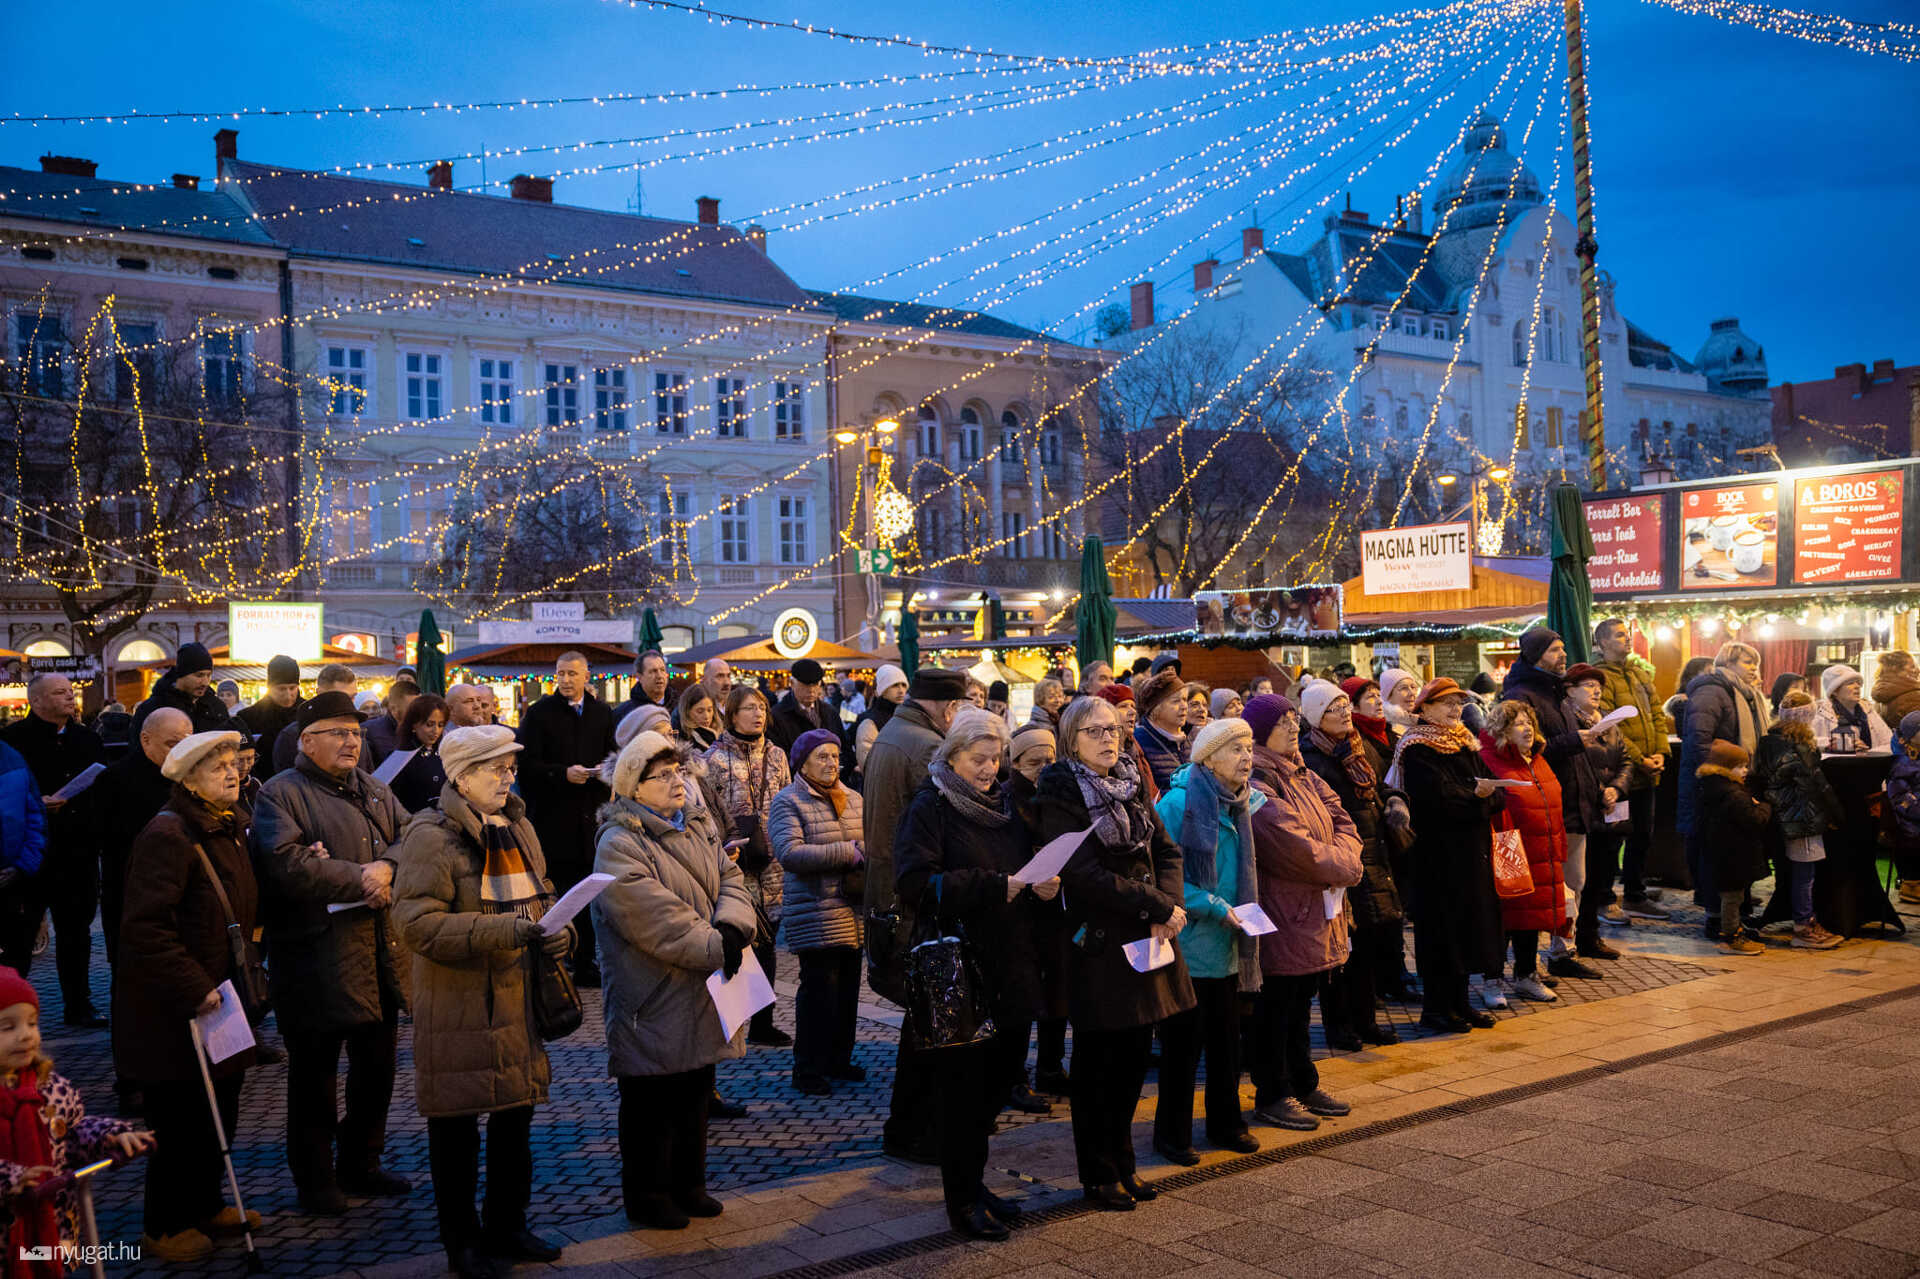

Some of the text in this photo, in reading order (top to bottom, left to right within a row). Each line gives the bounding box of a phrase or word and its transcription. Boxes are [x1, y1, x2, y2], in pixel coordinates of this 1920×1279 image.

[1801, 481, 1877, 505] A BOROS
[1587, 502, 1642, 521] Forralt Bor
[1589, 527, 1613, 544] orró
[1365, 528, 1466, 561] MAGNA HÜTTE
[1863, 540, 1893, 551] MERLOT
[1588, 572, 1611, 589] orró
[535, 625, 581, 635] KONTYOS
